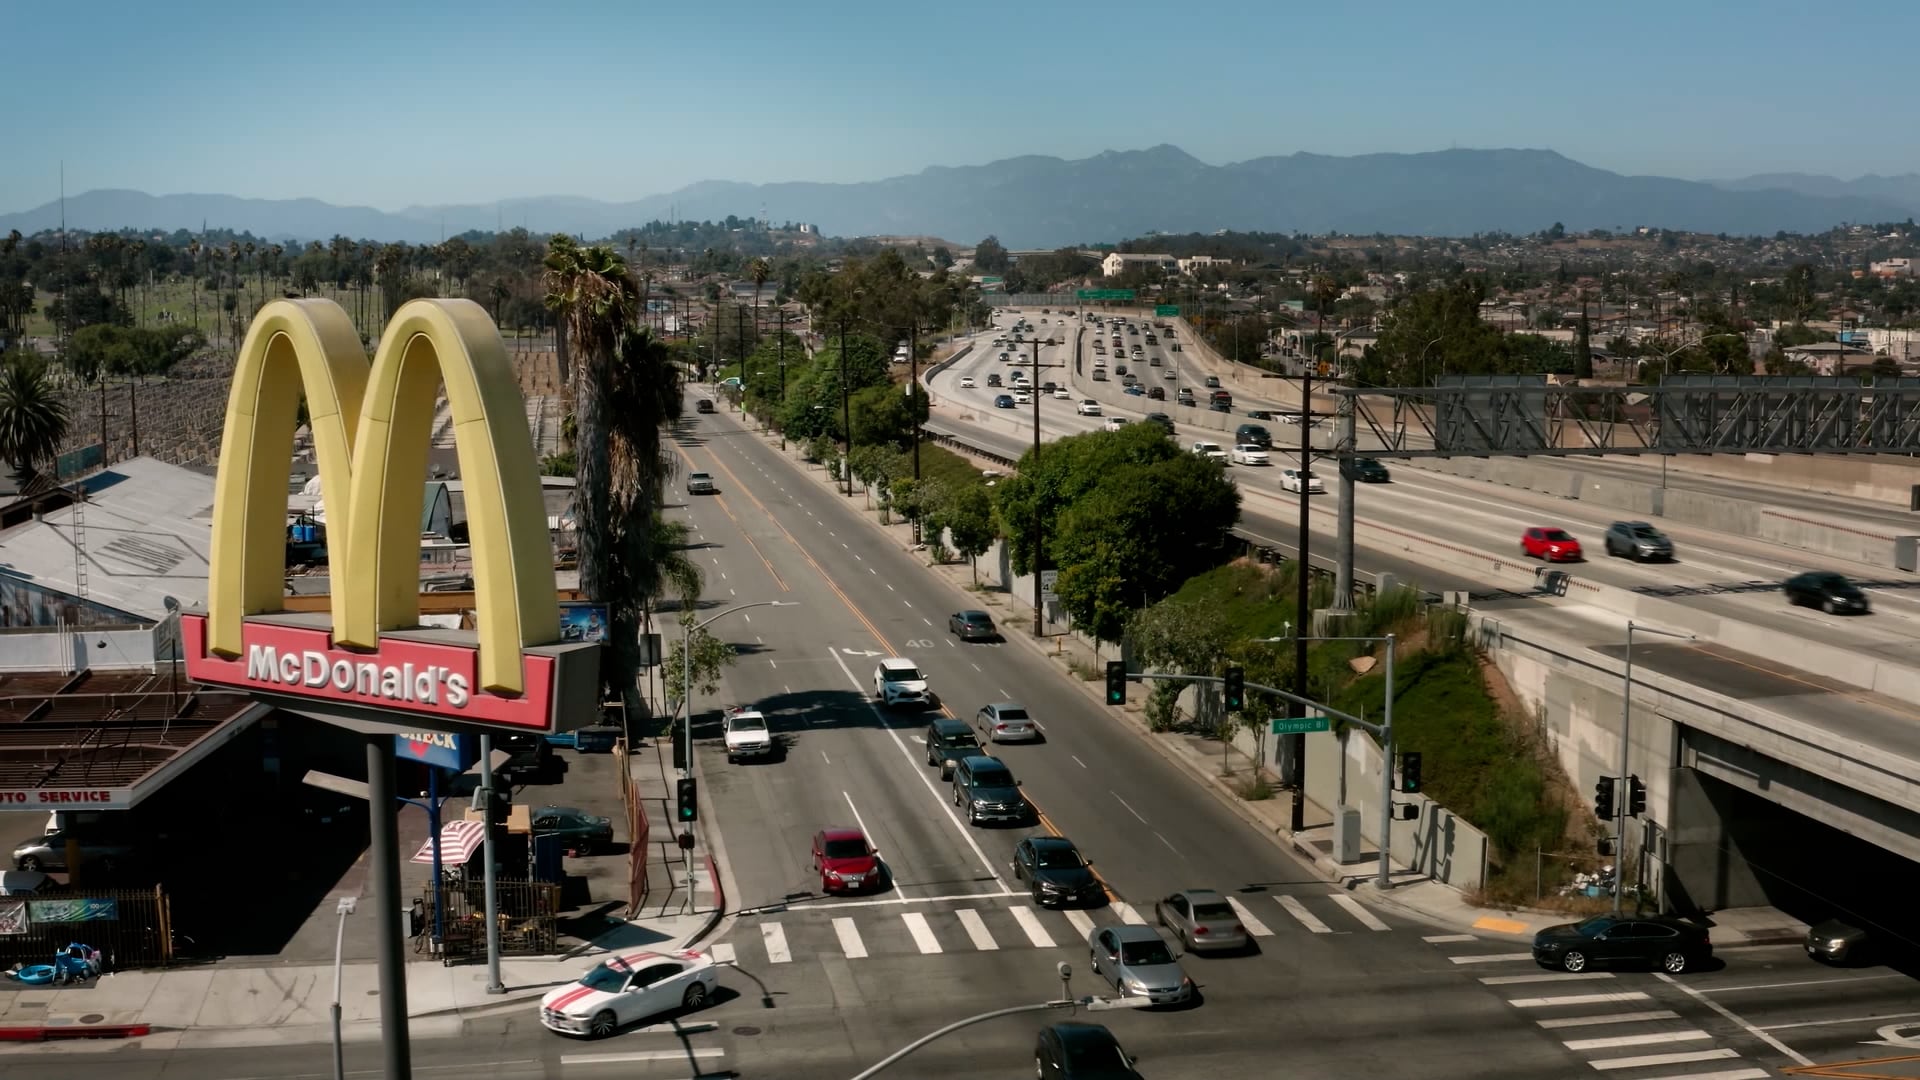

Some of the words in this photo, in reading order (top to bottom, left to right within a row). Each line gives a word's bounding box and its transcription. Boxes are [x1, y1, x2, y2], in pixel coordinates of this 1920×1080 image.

[905, 639, 935, 648] 40
[247, 644, 469, 708] McDonald's
[1279, 722, 1312, 731] Olympic
[38, 791, 111, 803] SERVICE
